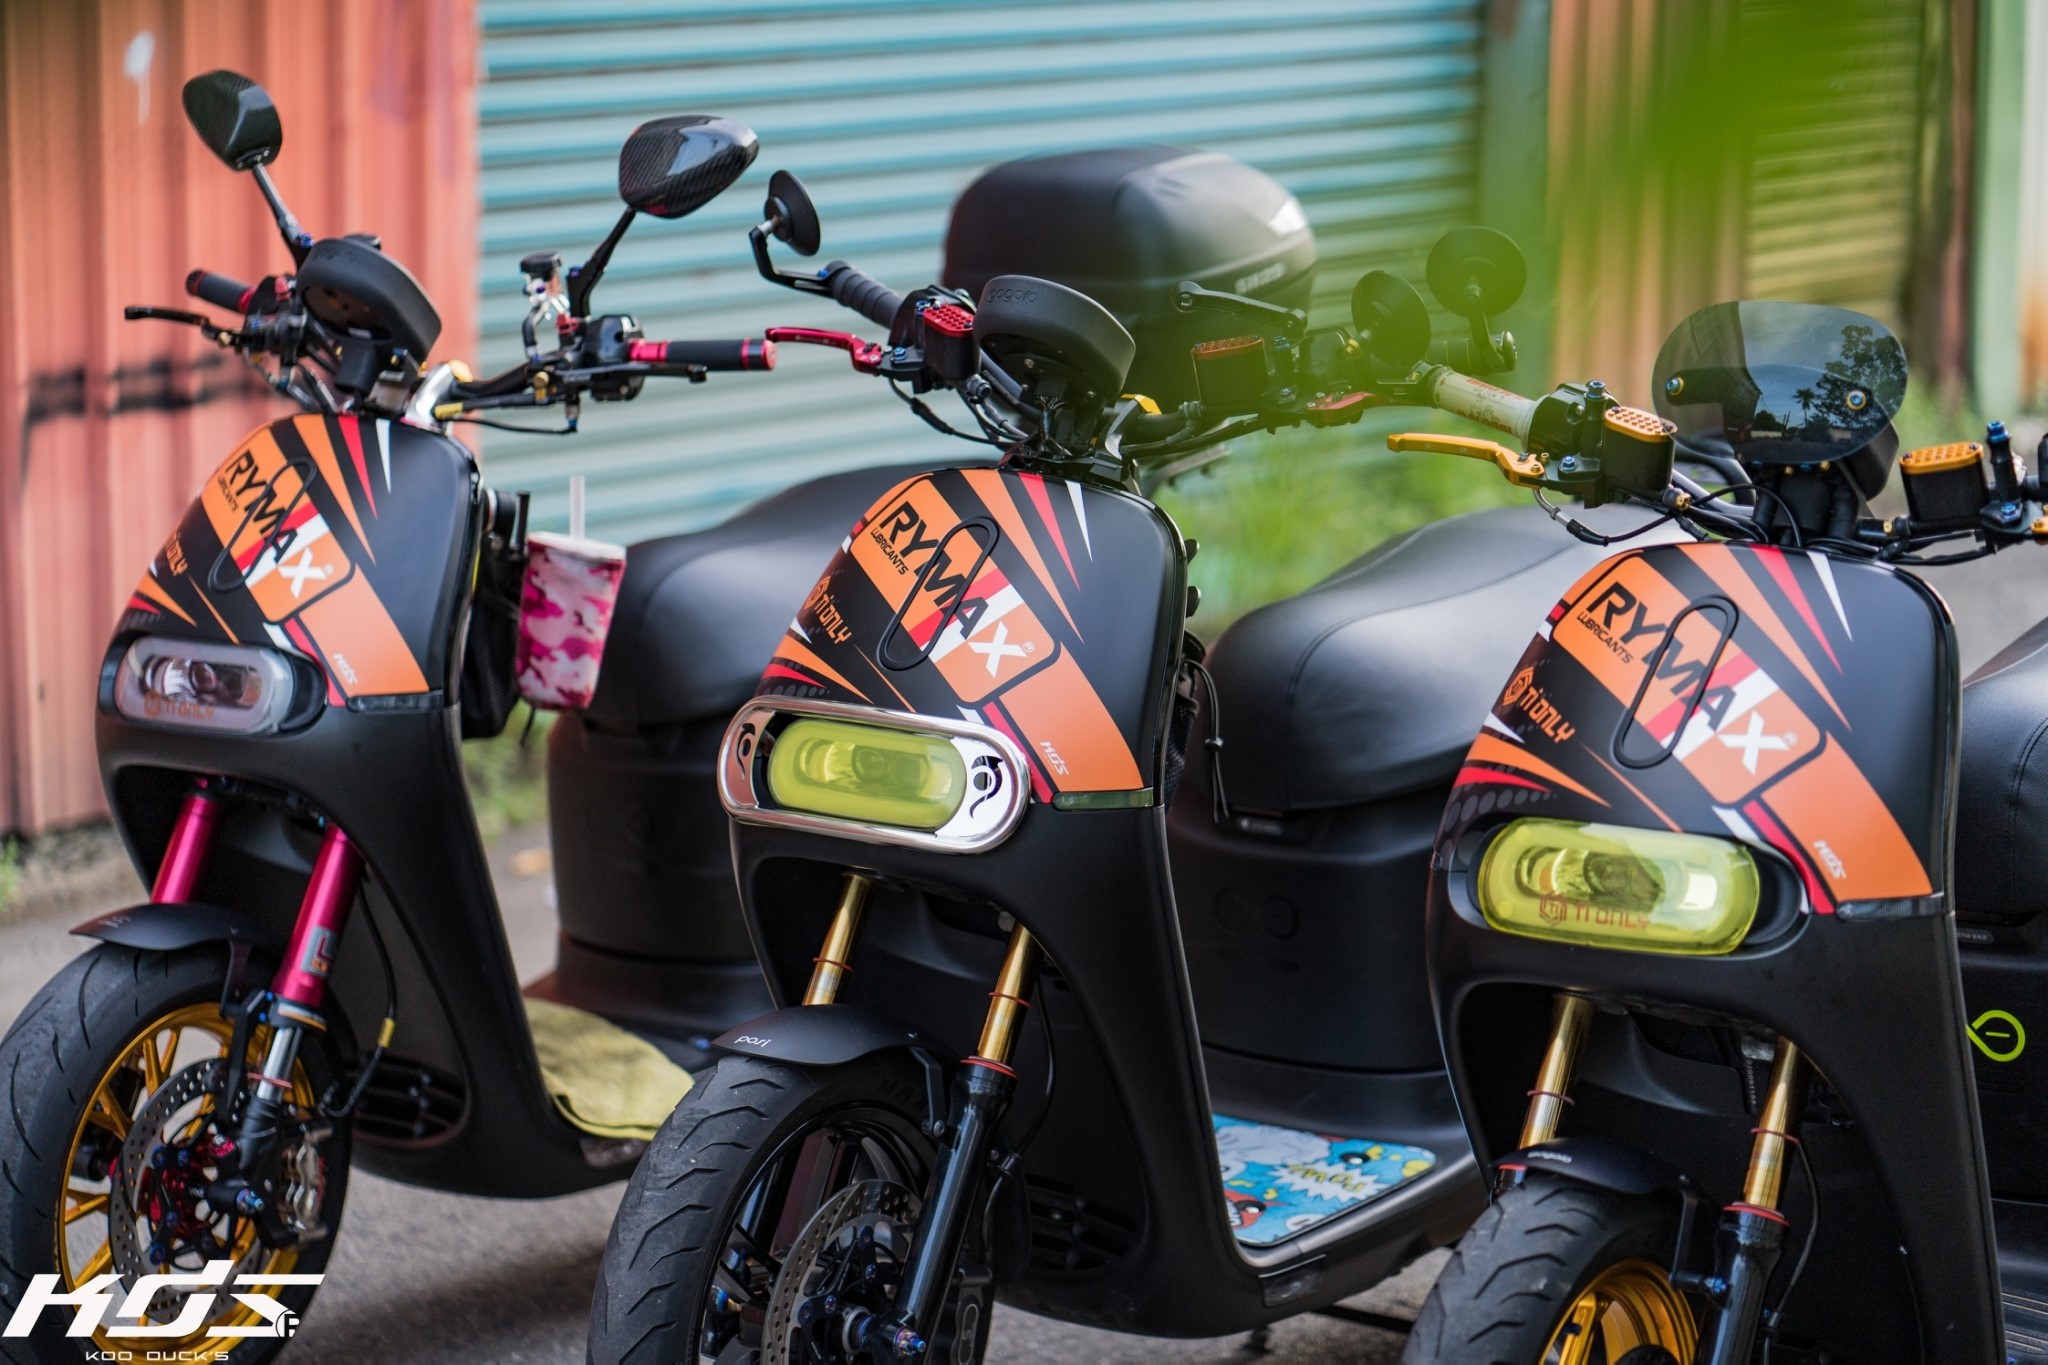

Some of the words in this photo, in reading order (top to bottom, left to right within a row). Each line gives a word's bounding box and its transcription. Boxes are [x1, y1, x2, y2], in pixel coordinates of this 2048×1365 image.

[987, 288, 1038, 303] gogoro
[225, 449, 327, 599] RYMAX
[870, 527, 909, 575] LUBRICANTS
[879, 501, 1028, 679] RYMAX
[1576, 611, 1634, 664] LUBRICANTS
[1586, 581, 1791, 775] RYMAX
